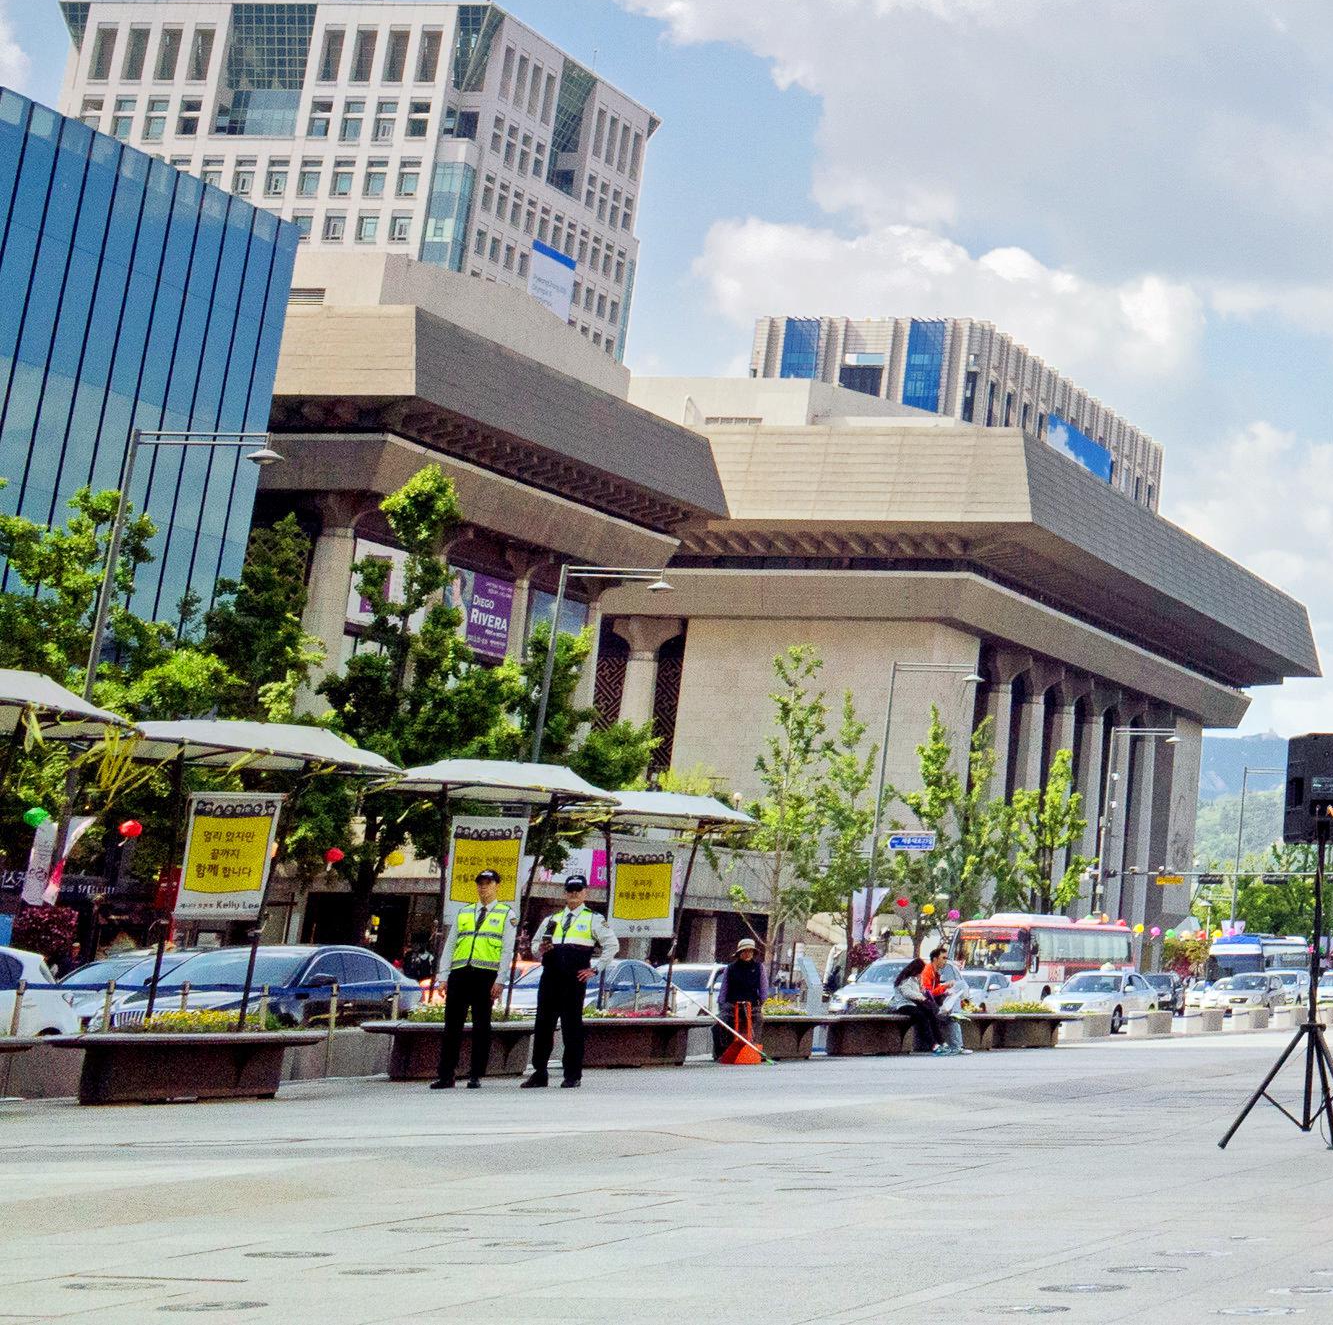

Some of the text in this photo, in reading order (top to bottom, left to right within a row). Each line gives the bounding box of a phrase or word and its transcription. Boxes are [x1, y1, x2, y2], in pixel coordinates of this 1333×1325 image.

[473, 594, 495, 609] DIEGO
[470, 608, 508, 632] RIVERA
[195, 863, 219, 879] 함께
[216, 899, 240, 911] Kelly
